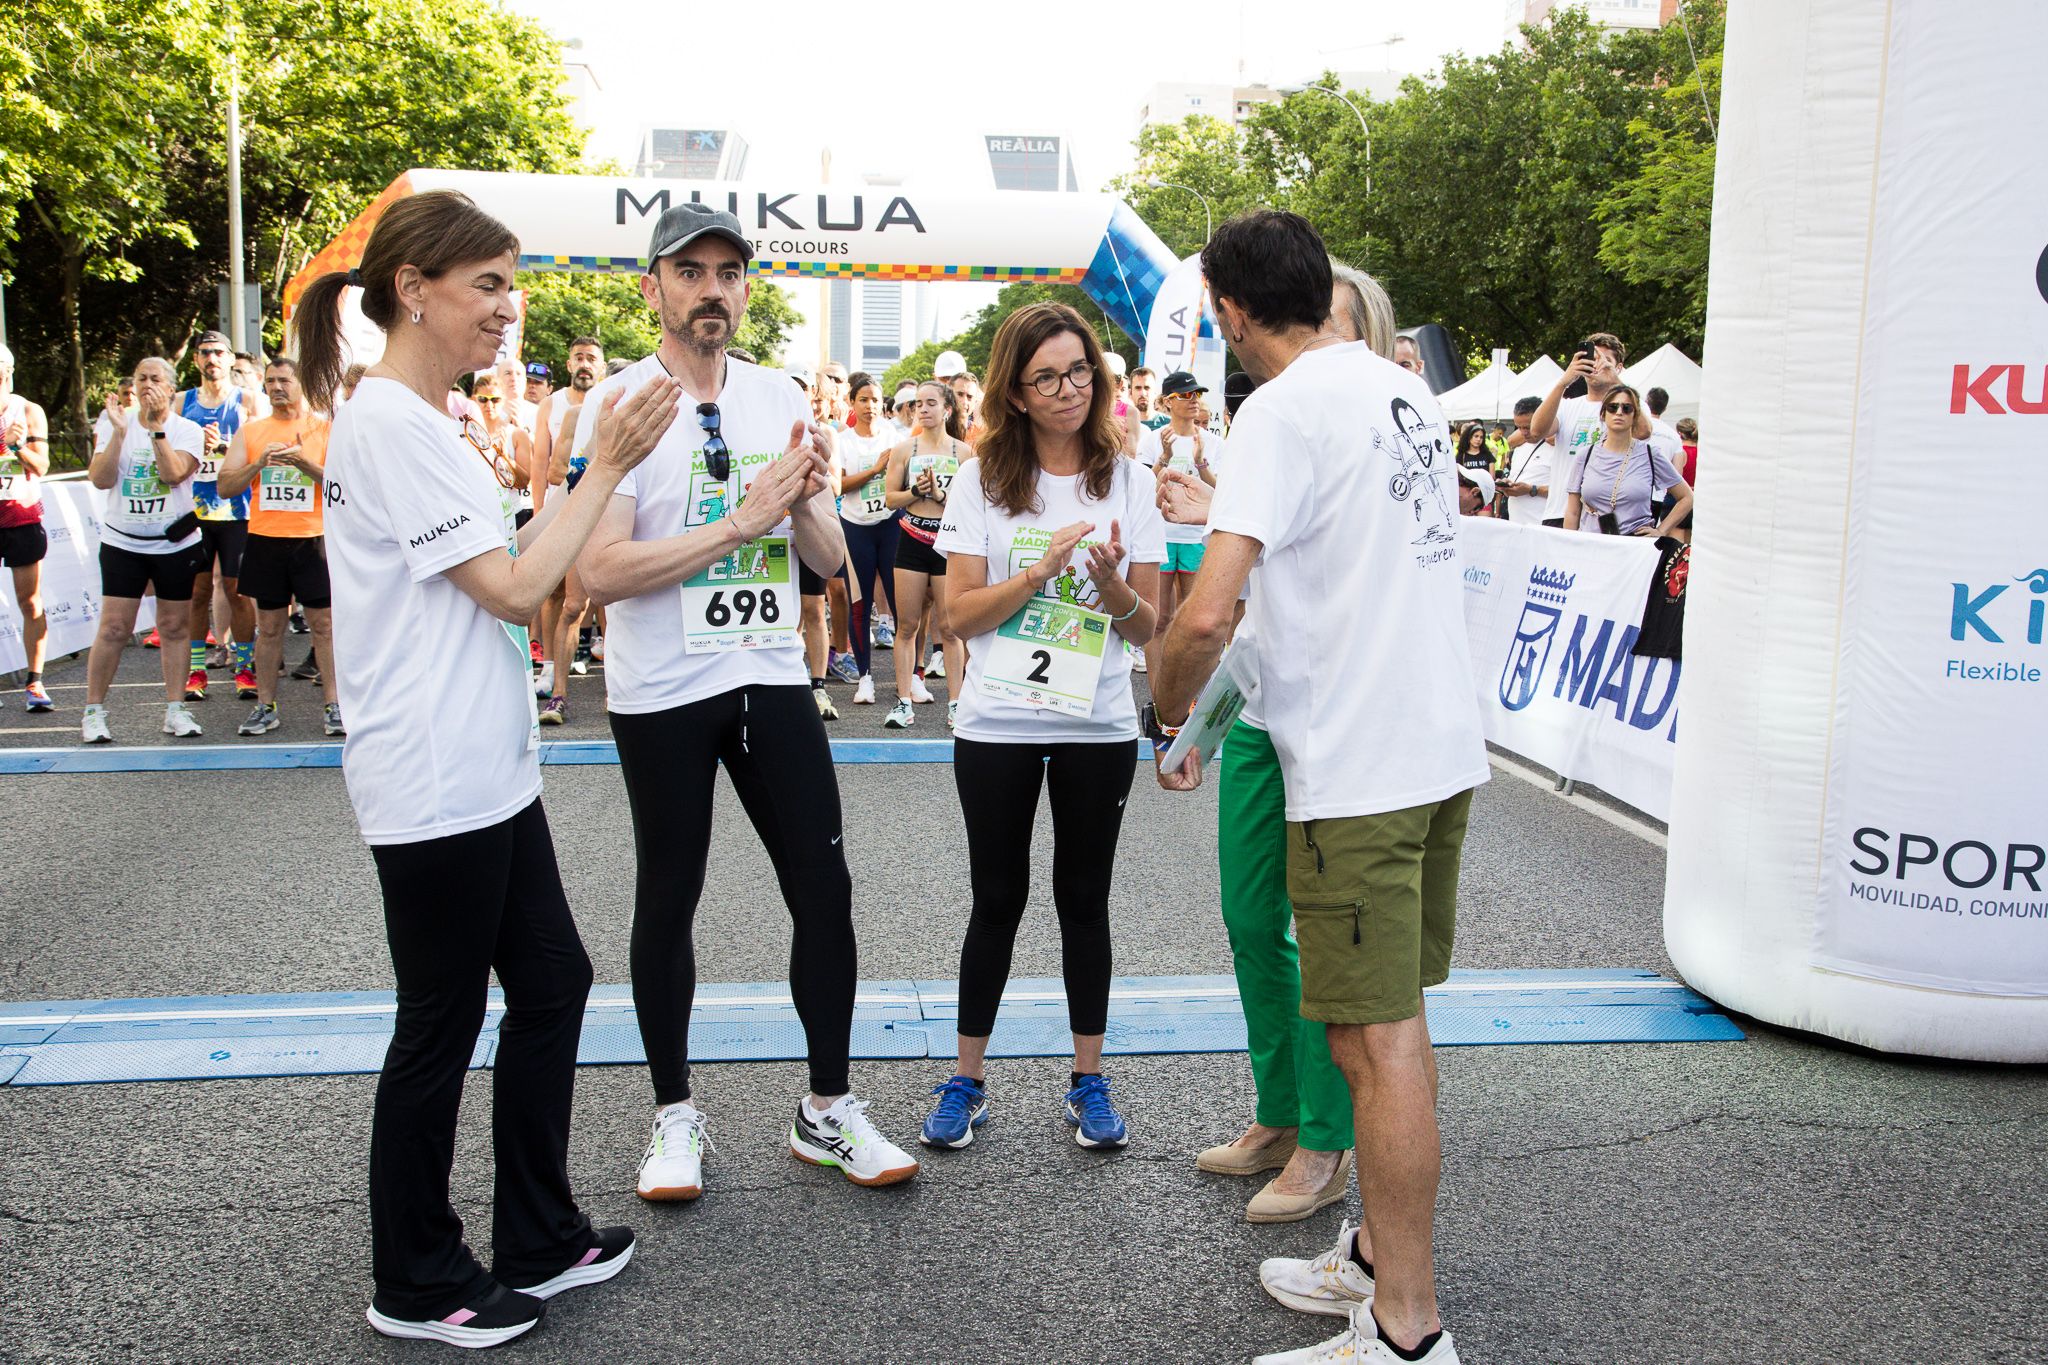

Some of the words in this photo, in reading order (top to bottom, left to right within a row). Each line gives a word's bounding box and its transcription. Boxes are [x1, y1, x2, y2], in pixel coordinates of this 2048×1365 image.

[769, 240, 849, 255] COLOURS
[741, 452, 768, 466] CON
[195, 462, 216, 474] 21
[266, 487, 306, 501] 1154
[868, 484, 885, 498] EL
[129, 497, 166, 514] 1177
[866, 499, 886, 514] 12
[409, 514, 470, 549] MUKUA
[1012, 537, 1052, 549] MADR
[705, 588, 780, 627] 698
[1027, 601, 1054, 613] MADRID
[1017, 608, 1081, 648] ELA
[1026, 649, 1052, 685] 2
[1946, 660, 2042, 682] Flexible
[1553, 613, 1682, 744] MAD
[1849, 827, 2047, 892] SPOR
[1849, 881, 1963, 917] MOVILIDAD,
